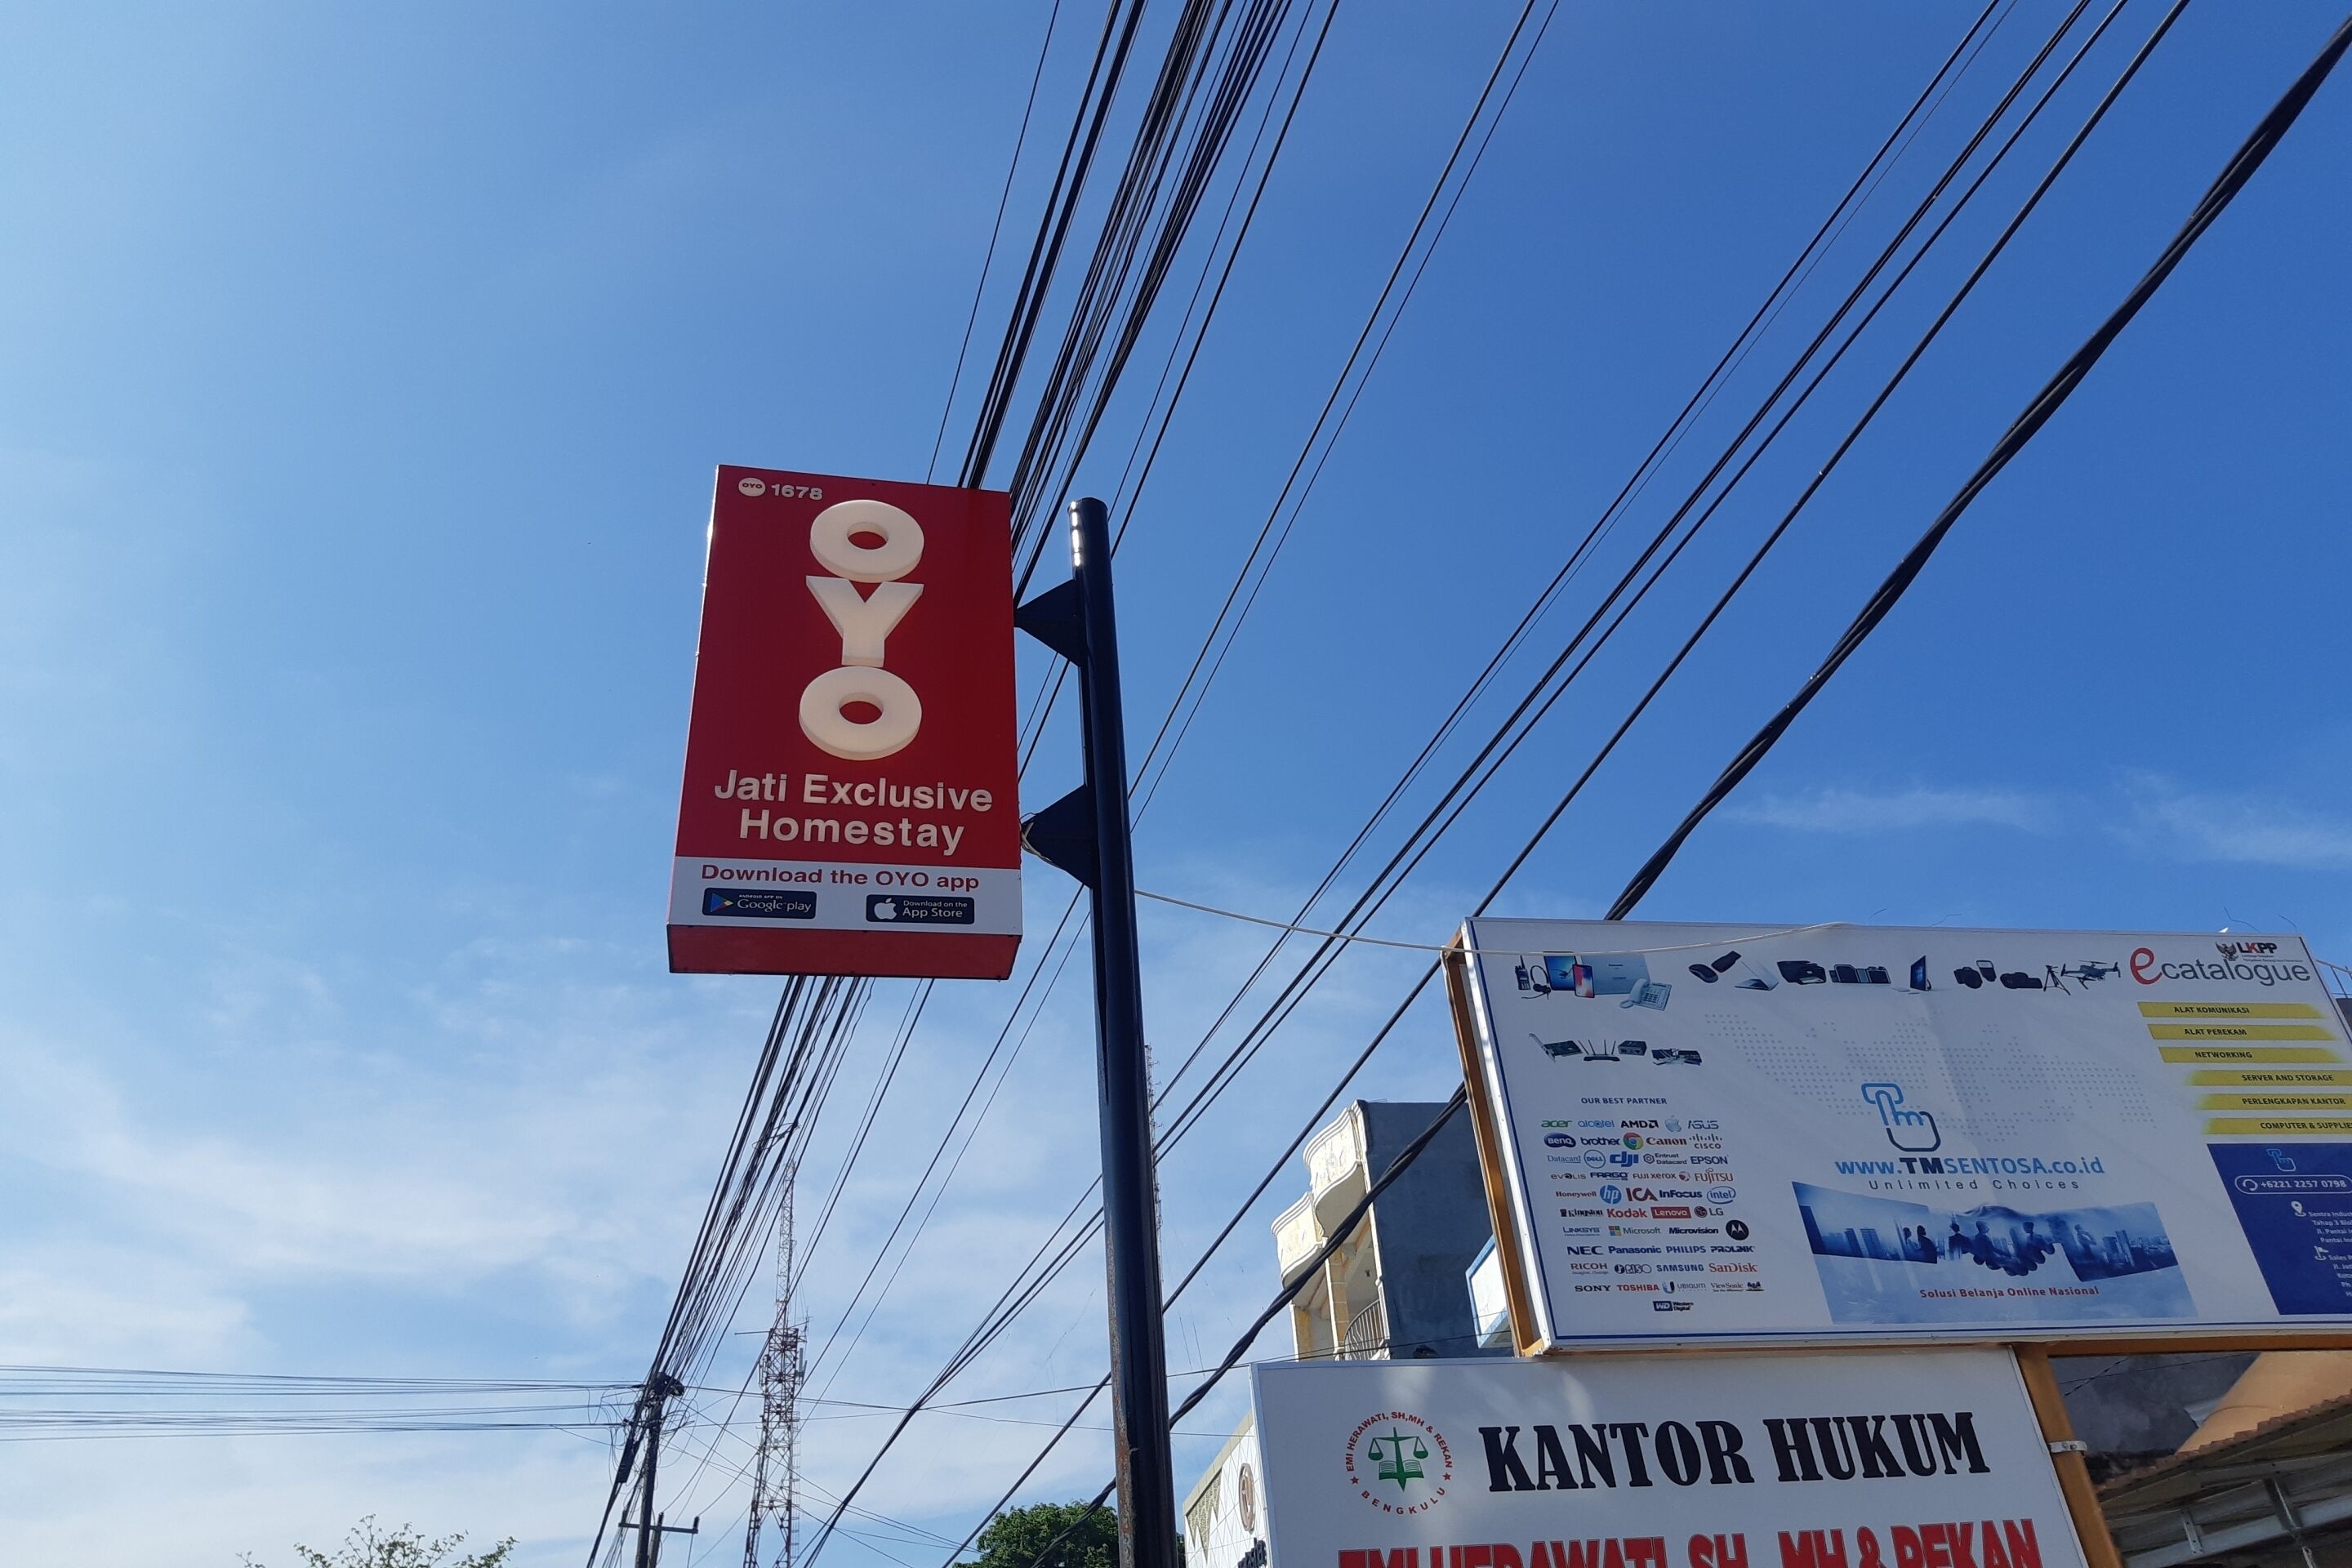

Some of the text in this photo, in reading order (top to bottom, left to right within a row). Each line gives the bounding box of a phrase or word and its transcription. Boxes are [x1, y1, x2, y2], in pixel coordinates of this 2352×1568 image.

[771, 483, 823, 501] 1678
[800, 499, 924, 760] OYO
[715, 769, 993, 812] Jati Exclusive
[739, 808, 964, 857] Homestay
[702, 864, 979, 892] Download the OYO app
[737, 899, 812, 913] Google play
[902, 906, 963, 919] App Store
[2236, 942, 2278, 954] LKPP
[2194, 1051, 2252, 1059] NETWORKING
[2242, 1074, 2333, 1082] SERVER AND STORAGE
[2310, 1098, 2345, 1106] KANTOR
[1620, 1120, 1649, 1128] AMD
[1580, 1137, 1620, 1145] brother
[1646, 1137, 1687, 1146] Canon
[1690, 1156, 1728, 1165] EPSON
[1834, 1156, 2105, 1176] www.TMSENTOSA.co.id
[1869, 1179, 2079, 1191] Unlimited Choices
[2295, 1180, 2319, 1188] 2257
[2321, 1180, 2347, 1188] 0798
[1625, 1187, 1659, 1201] ICA
[1606, 1208, 1647, 1218] Kodak
[1708, 1208, 1724, 1216] LG
[1566, 1245, 1604, 1255] NEC
[1608, 1245, 1662, 1254] Panasonic
[1666, 1245, 1706, 1254] PHILIPS
[1708, 1263, 1757, 1272] SanDisk
[1919, 1285, 2099, 1298] Solusi Belanja Online Nasional
[1346, 1453, 1354, 1472] EMI
[1433, 1433, 1453, 1468] REKAN
[1478, 1411, 1991, 1493] KANTOR HUKUM
[1361, 1487, 1446, 1515] BENGKULU
